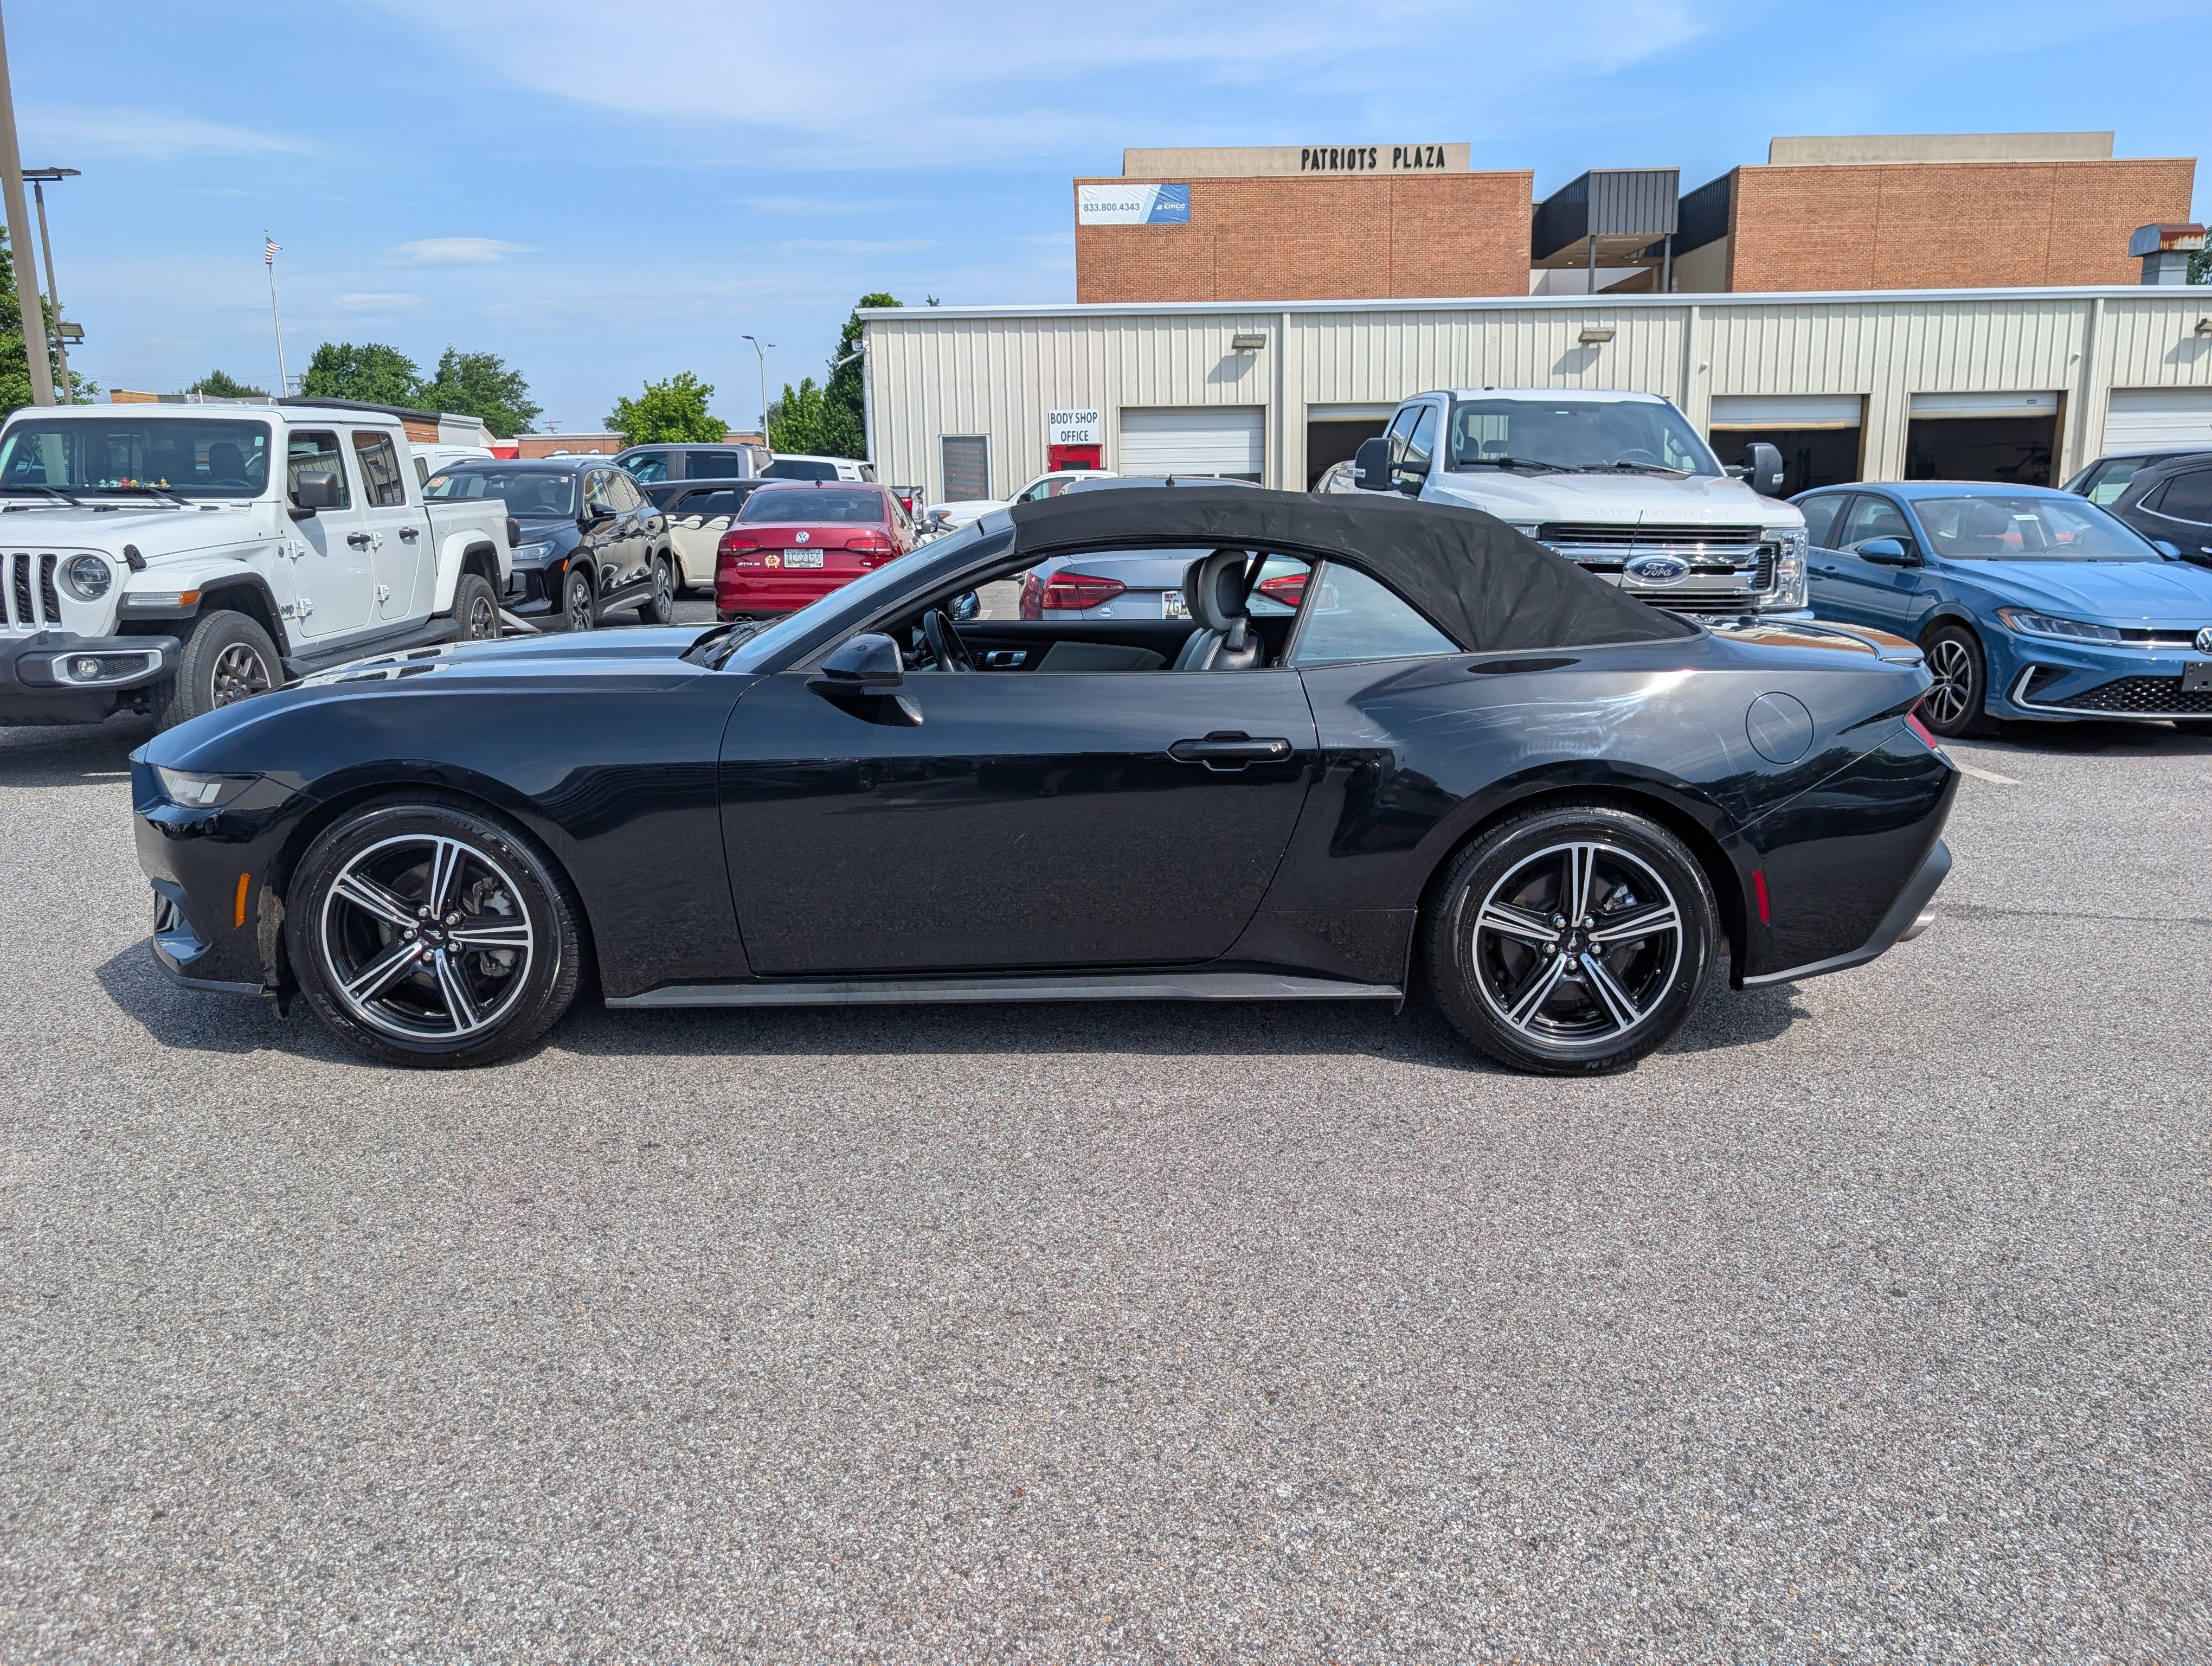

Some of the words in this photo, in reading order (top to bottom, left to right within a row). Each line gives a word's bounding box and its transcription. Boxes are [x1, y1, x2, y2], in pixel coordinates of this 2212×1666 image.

[1301, 147, 1377, 171] PATRIOTS
[1393, 146, 1445, 169] PLAZA
[1084, 203, 1140, 212] 833.800.4343
[1051, 413, 1073, 424] BODY
[1075, 412, 1097, 424] SHOP
[1060, 430, 1089, 442] OFFICE
[1642, 562, 1673, 577] Ford
